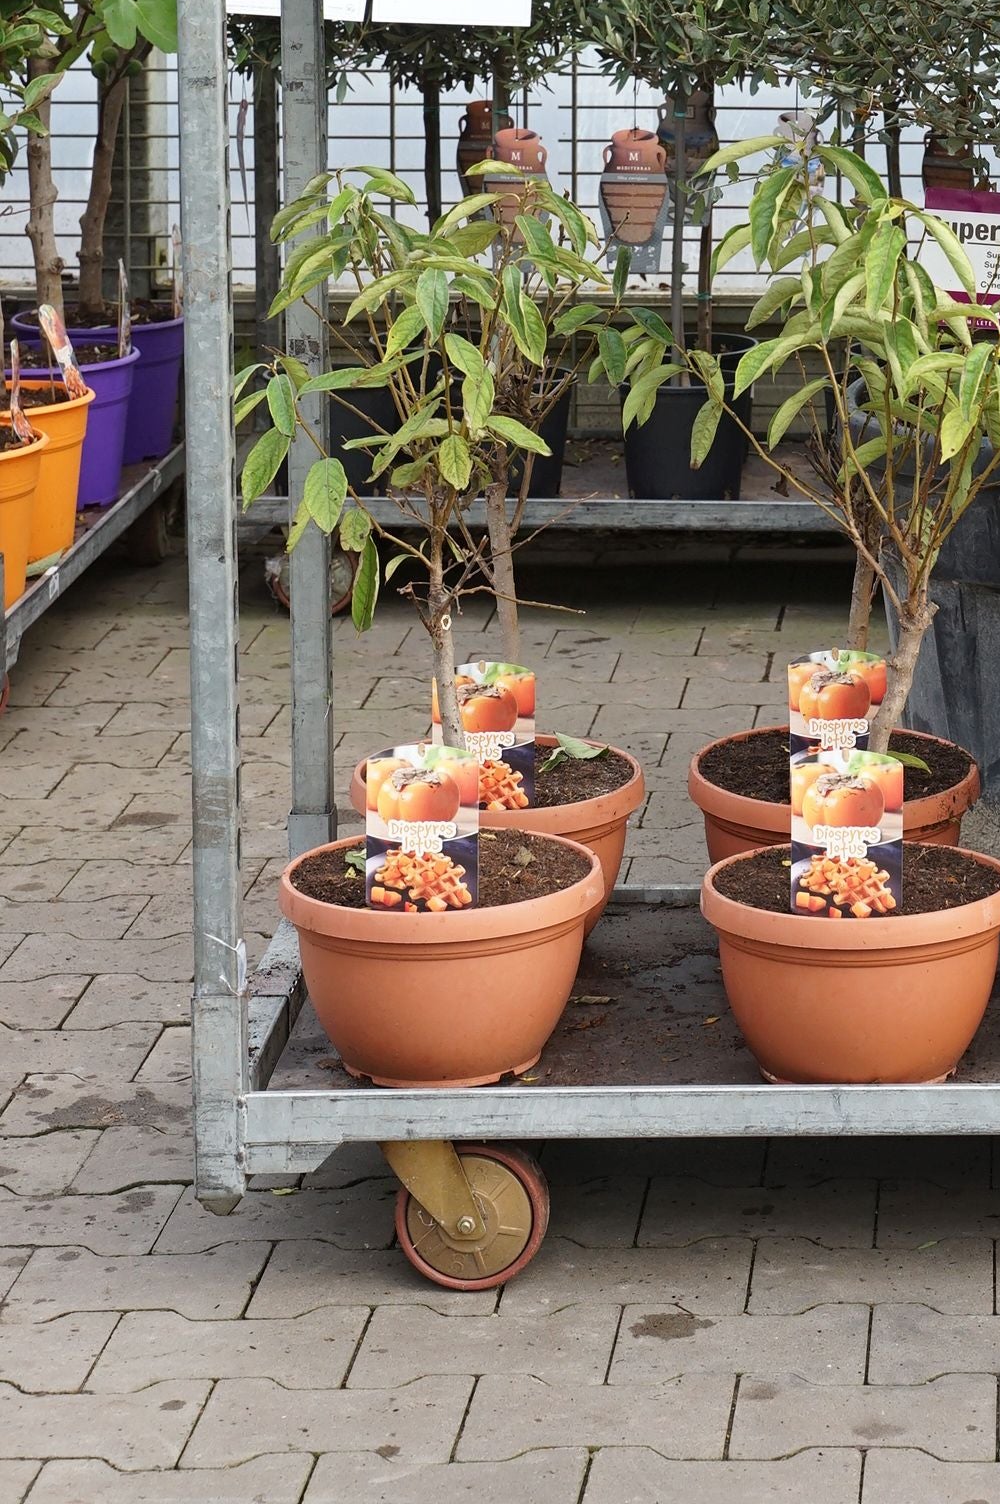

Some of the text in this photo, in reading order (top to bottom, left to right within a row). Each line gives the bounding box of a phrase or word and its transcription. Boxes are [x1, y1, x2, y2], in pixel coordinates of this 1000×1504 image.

[811, 720, 866, 734] Diospyros
[466, 732, 512, 747] ospyros
[823, 734, 854, 748] lotus
[391, 822, 454, 838] Diospyros
[816, 828, 878, 844] Diospyros
[404, 837, 440, 854] lotus
[828, 843, 865, 859] lotus
